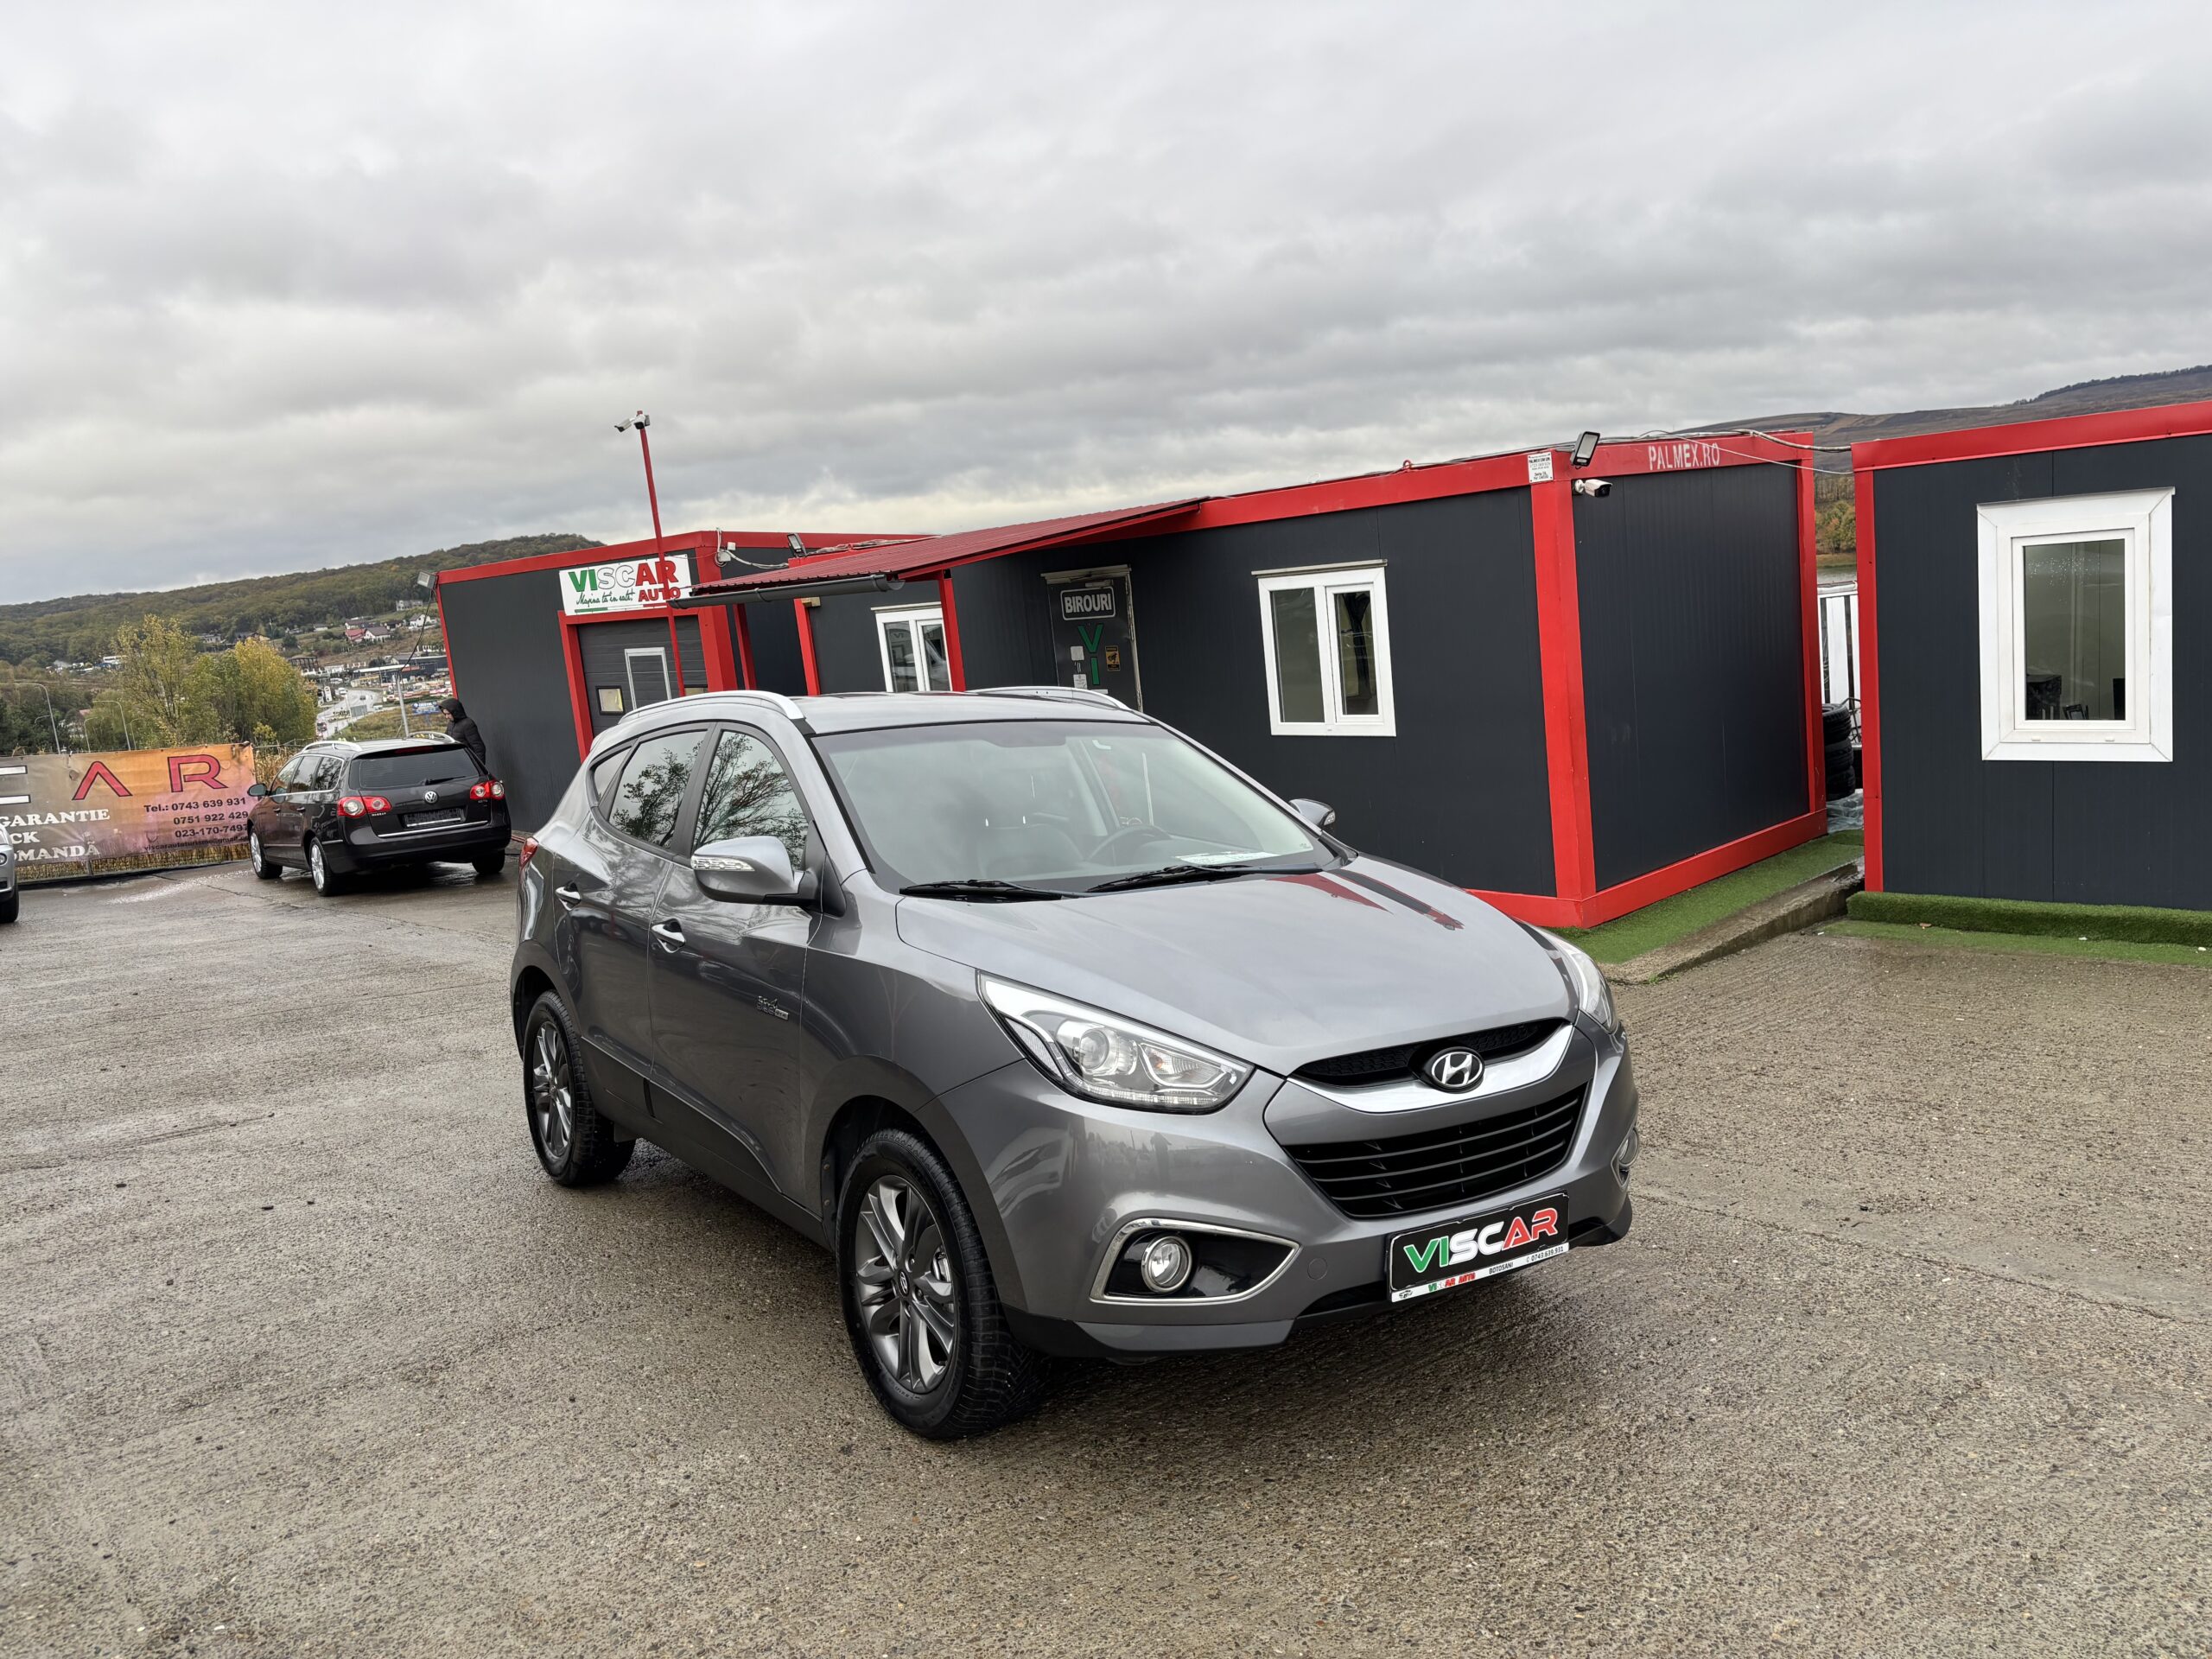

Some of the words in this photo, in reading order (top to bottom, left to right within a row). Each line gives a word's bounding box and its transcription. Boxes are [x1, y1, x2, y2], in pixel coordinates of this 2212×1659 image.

[1648, 442, 1719, 470] PALMEX.RO
[568, 561, 679, 593] VISCAR
[638, 587, 681, 602] AUTO
[1064, 593, 1113, 613] BIROURI
[171, 802, 199, 810] 0743
[202, 799, 223, 808] 639
[0, 809, 110, 827] GARANTIE
[173, 816, 200, 825] 0751
[204, 813, 225, 822] 922
[228, 810, 249, 819] 429
[9, 831, 41, 844] CK
[1404, 1208, 1558, 1273] VISCAR
